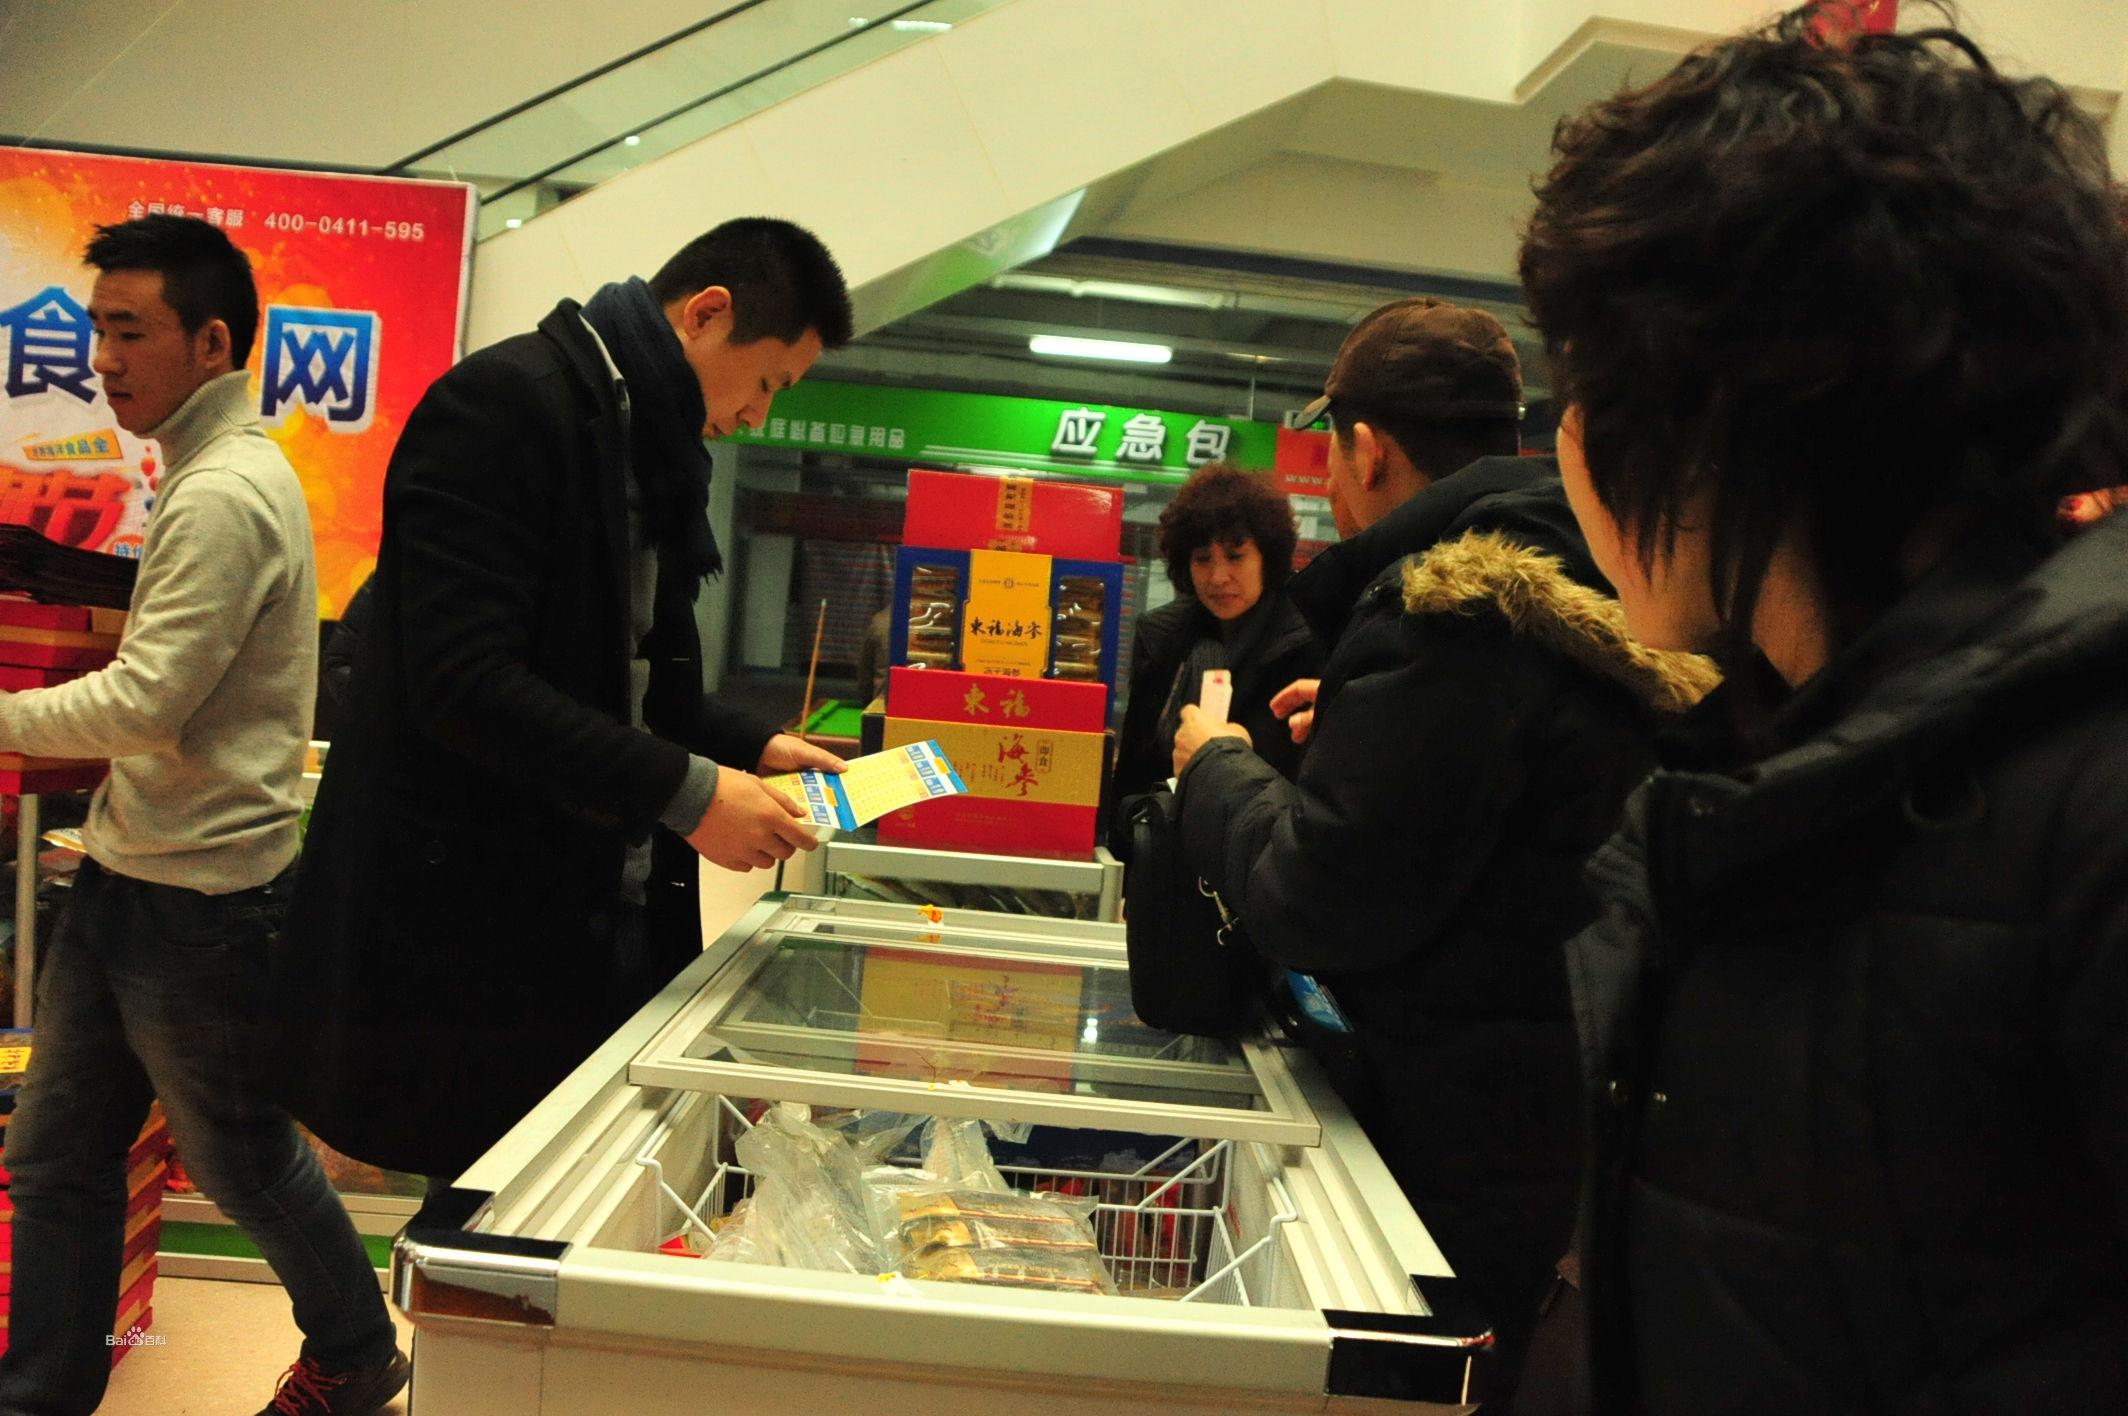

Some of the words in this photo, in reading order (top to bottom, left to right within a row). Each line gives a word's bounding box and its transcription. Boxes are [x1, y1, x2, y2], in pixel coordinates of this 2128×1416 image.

[264, 211, 425, 241] 400-0411-595
[260, 303, 375, 422] 网
[1051, 407, 1231, 466] 应急包
